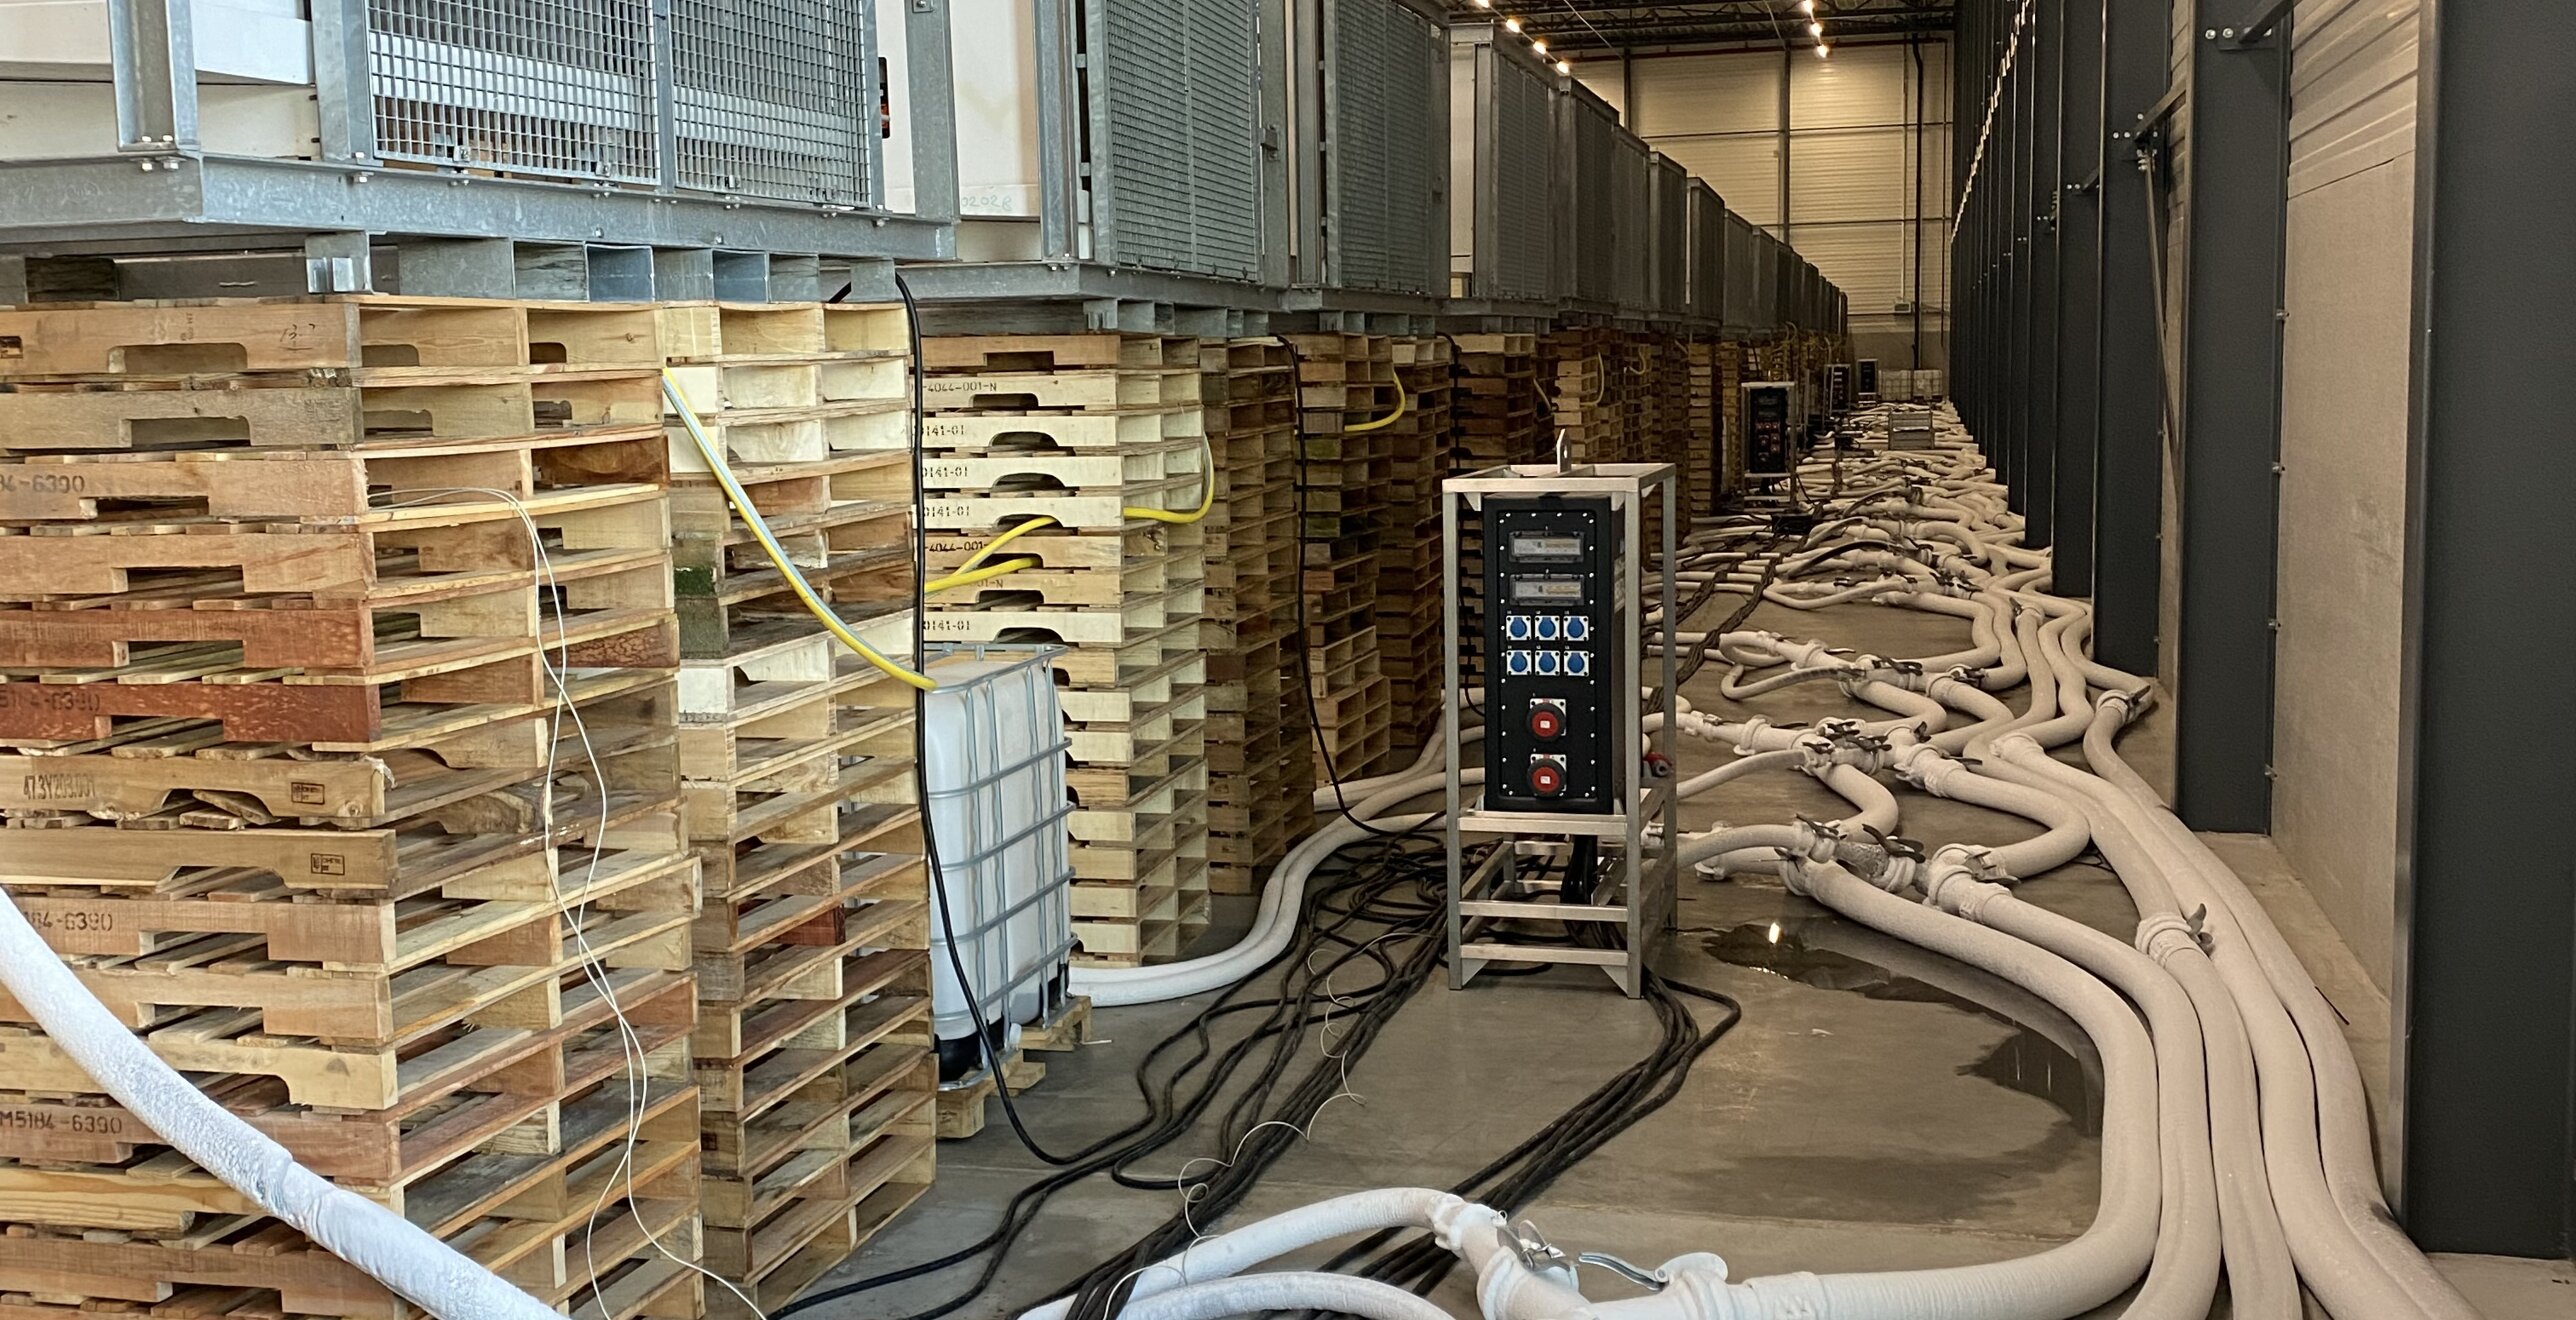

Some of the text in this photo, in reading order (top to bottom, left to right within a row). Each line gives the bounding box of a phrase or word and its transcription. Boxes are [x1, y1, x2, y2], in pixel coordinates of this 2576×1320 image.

[910, 381, 998, 393] -4044-001-N
[922, 424, 964, 437] 141-01
[924, 540, 988, 552] -4044-001-
